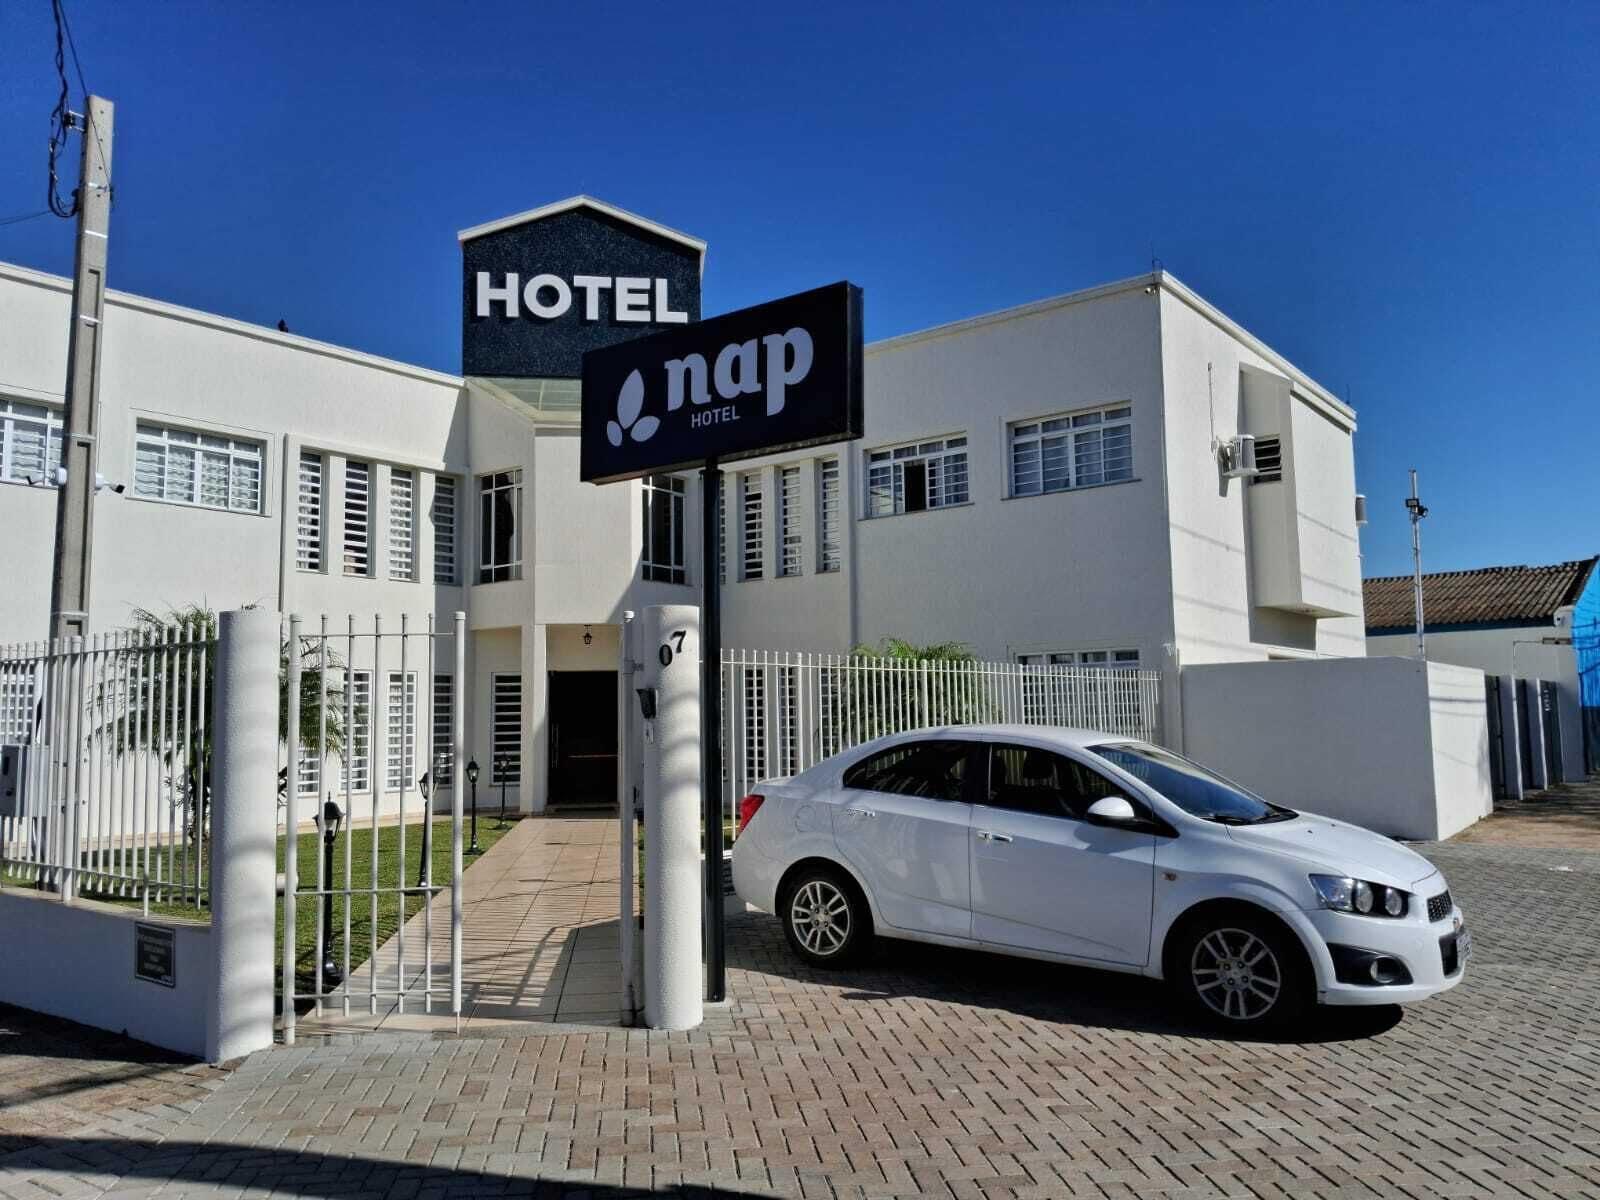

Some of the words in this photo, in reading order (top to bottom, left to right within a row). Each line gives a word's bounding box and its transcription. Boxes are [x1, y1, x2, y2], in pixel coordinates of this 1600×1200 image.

[477, 272, 688, 323] HOTEL
[664, 327, 814, 416] nap
[691, 405, 741, 429] HOTEL
[659, 630, 686, 666] 07
